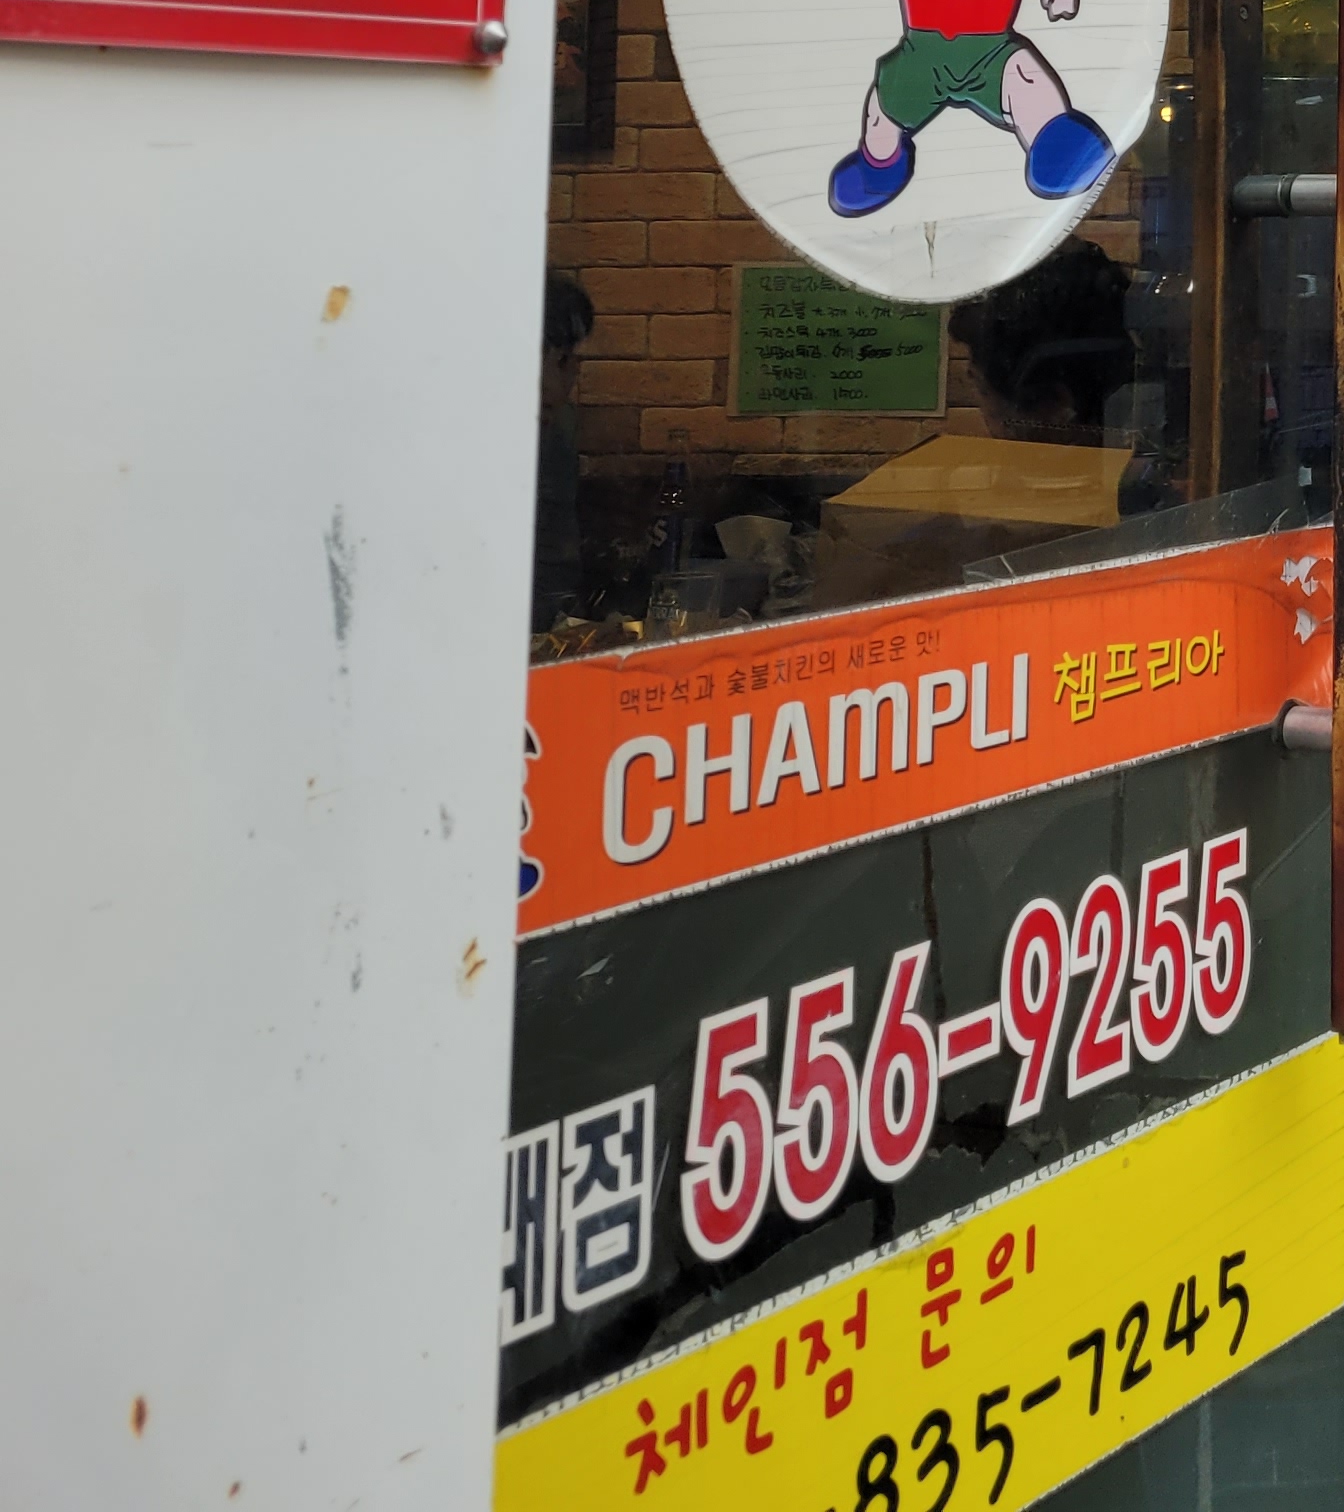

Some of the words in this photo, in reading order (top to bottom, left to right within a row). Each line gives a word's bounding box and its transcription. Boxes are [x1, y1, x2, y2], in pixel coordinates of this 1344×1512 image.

[846, 633, 907, 673] 새로운
[1052, 628, 1226, 724] 챔프리아
[680, 826, 1252, 1264] 556-9255
[623, 1289, 869, 1496] 체인점
[919, 1224, 1037, 1373] 문의
